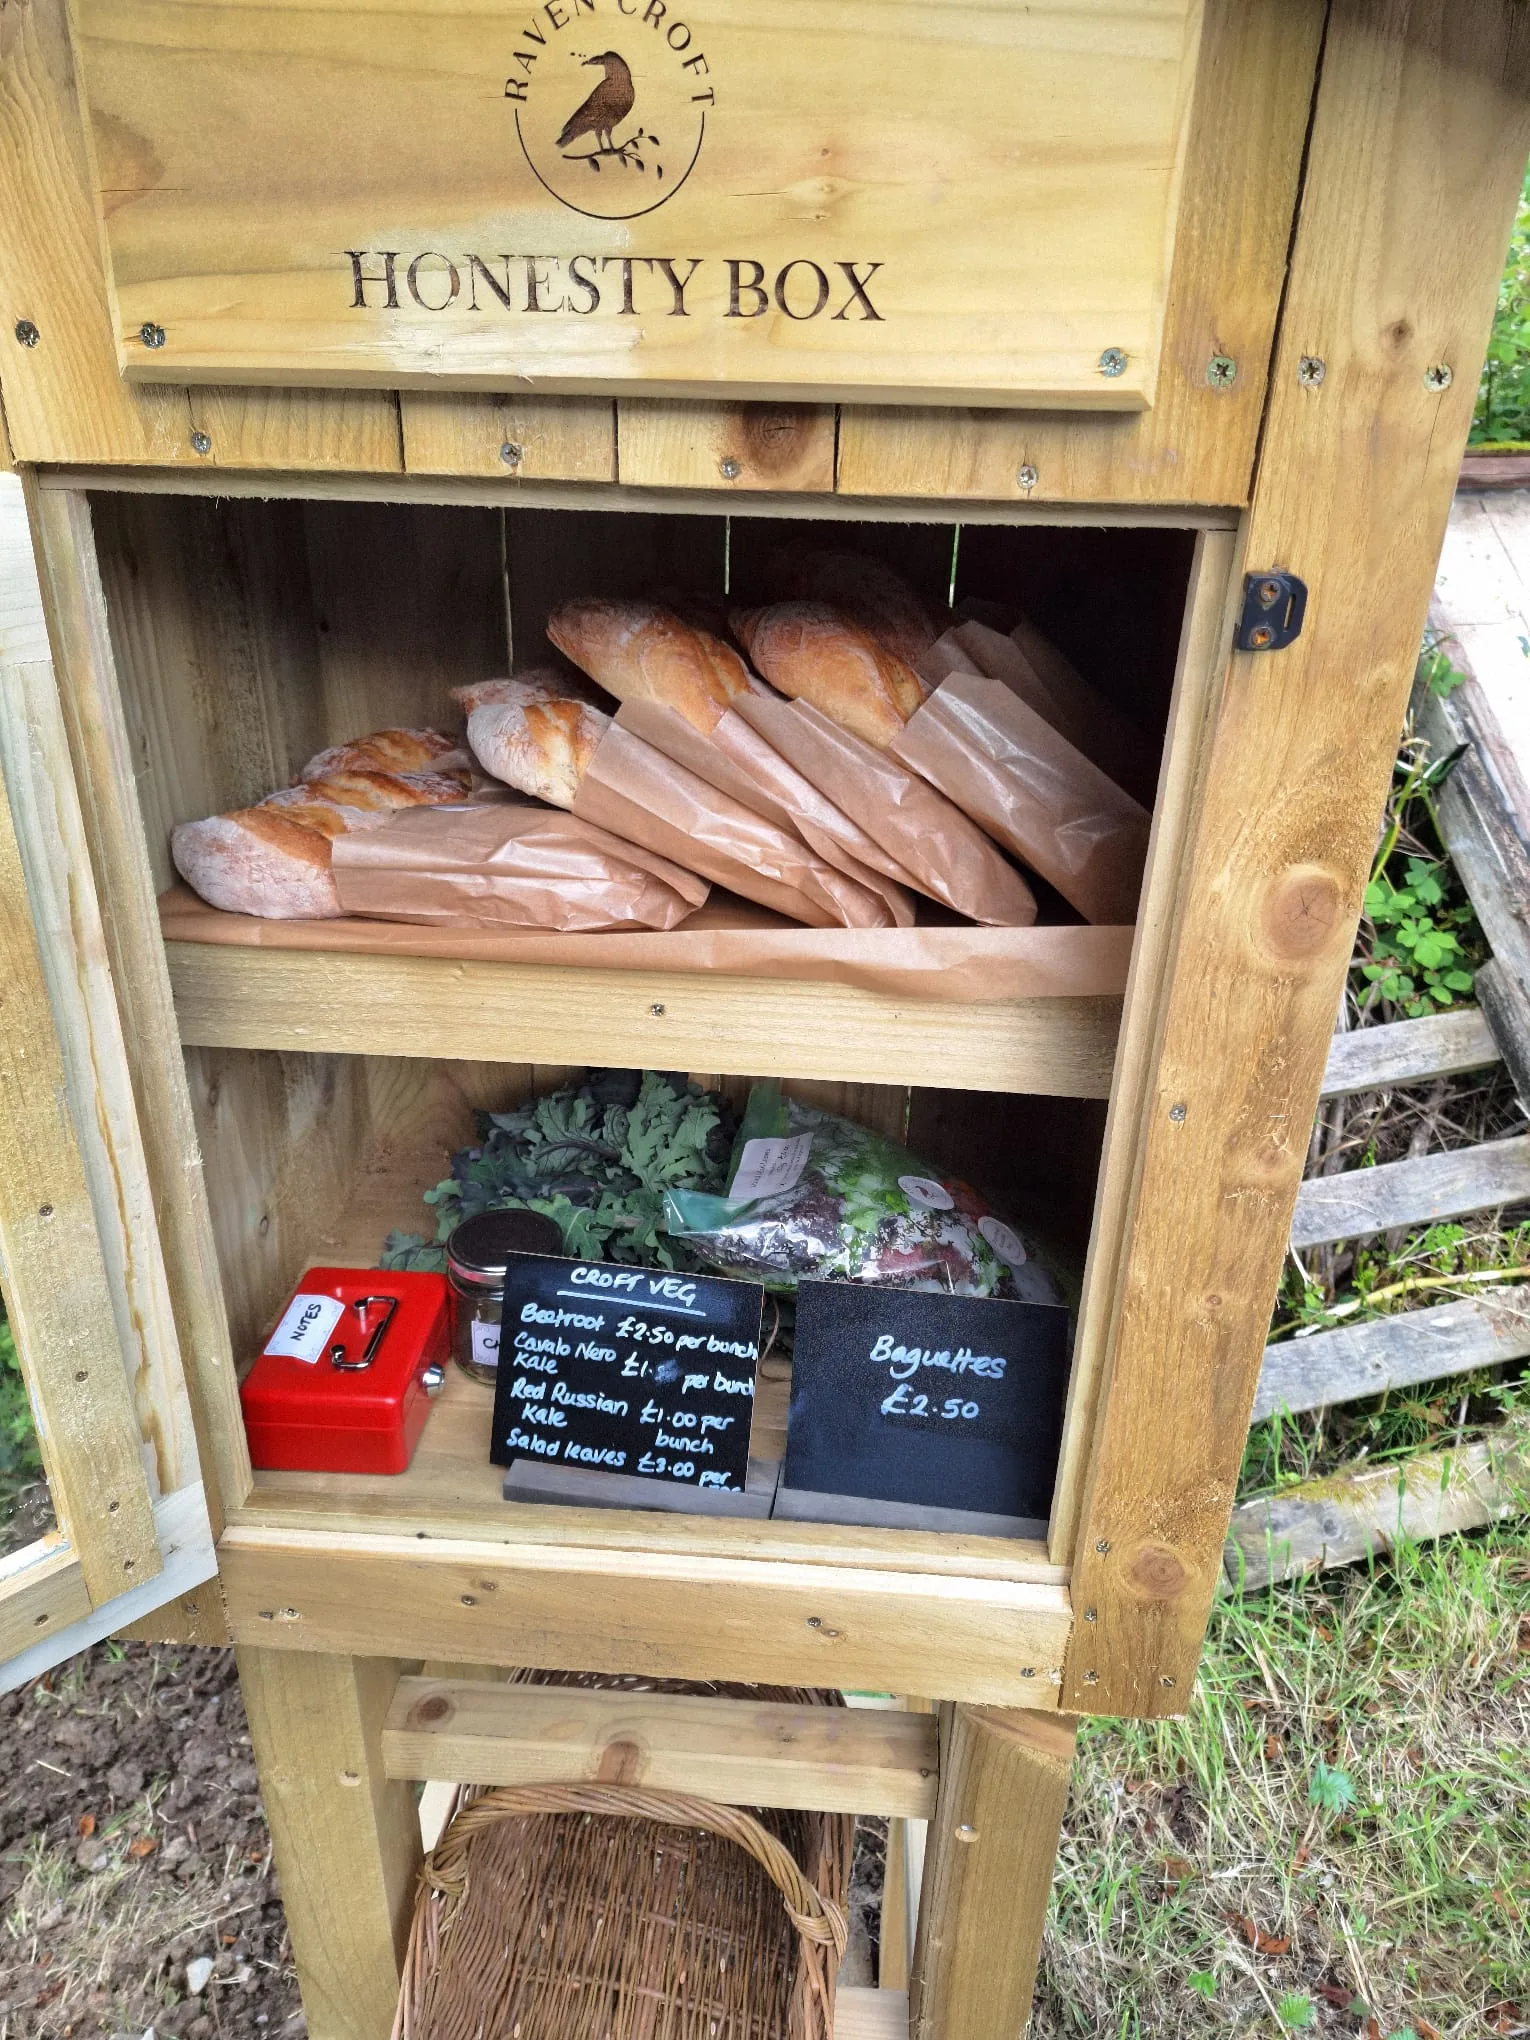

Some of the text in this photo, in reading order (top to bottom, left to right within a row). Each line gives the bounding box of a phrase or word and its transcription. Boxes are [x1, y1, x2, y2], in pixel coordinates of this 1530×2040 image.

[344, 250, 887, 321] HONESTY BOX
[570, 1266, 697, 1308] CROFT VEG
[289, 1303, 322, 1342] NOTES
[615, 1316, 675, 1344] £2.50
[675, 1334, 708, 1352] per
[706, 1334, 759, 1361] bunch
[512, 1351, 559, 1375] Kale
[513, 1331, 571, 1357] Cavalo
[574, 1341, 617, 1362] Nero
[681, 1374, 710, 1395] per
[869, 1334, 1007, 1379] Baguettes
[510, 1376, 736, 1435] Red Russian £1.00 per
[880, 1382, 980, 1419] £2.50
[521, 1402, 715, 1455] Kale bunch
[506, 1427, 732, 1488] Salad leaves £3.00 per
